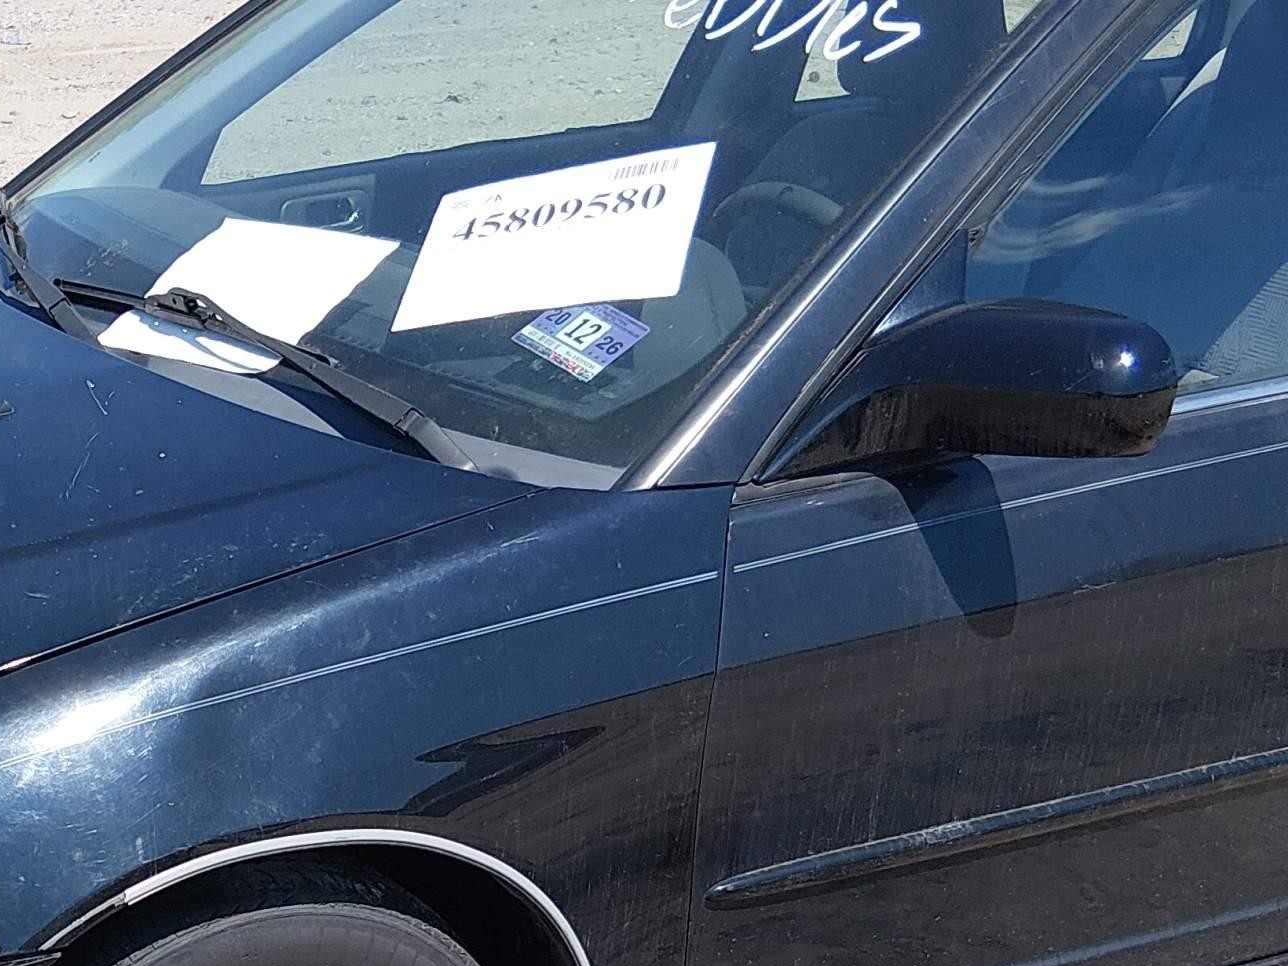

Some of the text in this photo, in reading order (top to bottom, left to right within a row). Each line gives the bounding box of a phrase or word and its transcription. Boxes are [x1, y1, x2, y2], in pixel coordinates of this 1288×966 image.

[452, 183, 667, 241] 45809580
[545, 309, 572, 326] 20
[564, 319, 602, 345] 12
[595, 336, 624, 356] 26
